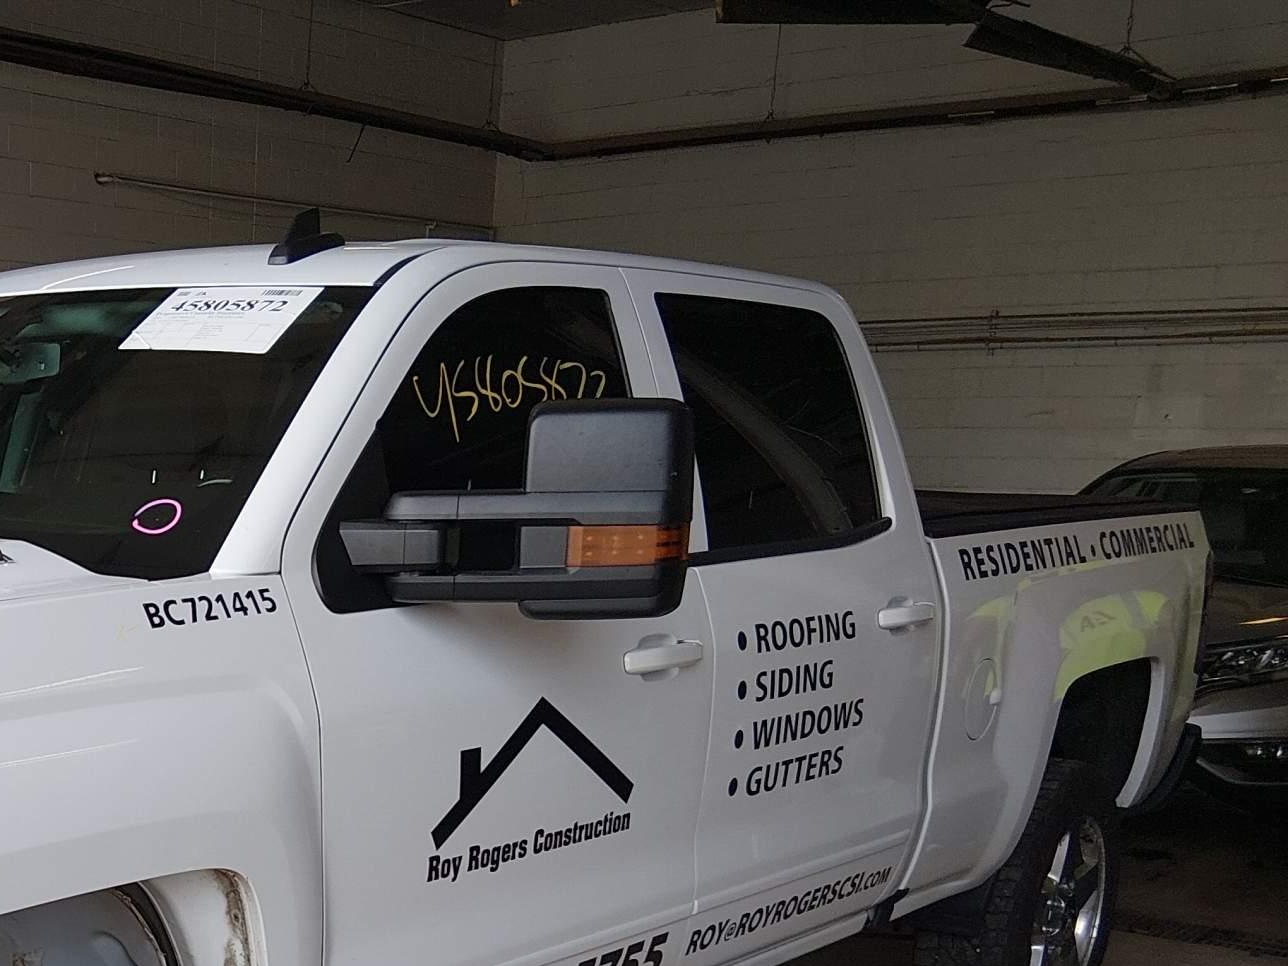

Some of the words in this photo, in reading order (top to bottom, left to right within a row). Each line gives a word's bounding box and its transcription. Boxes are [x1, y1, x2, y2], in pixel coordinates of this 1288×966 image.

[171, 299, 289, 313] 45805872
[958, 534, 1087, 581] RESIDENTIAL
[1098, 523, 1195, 560] COMMERCIAL
[143, 588, 278, 629] BC721415
[754, 610, 857, 654] ROOFING
[754, 659, 834, 702] SIDING
[752, 698, 865, 751] WINDOWS
[745, 746, 844, 797] GUTTERS
[426, 853, 462, 883] Roy
[467, 837, 528, 874] Rogers
[533, 811, 632, 856] Construction
[685, 865, 892, 957] ROY@ROYROGERSCSI.COM
